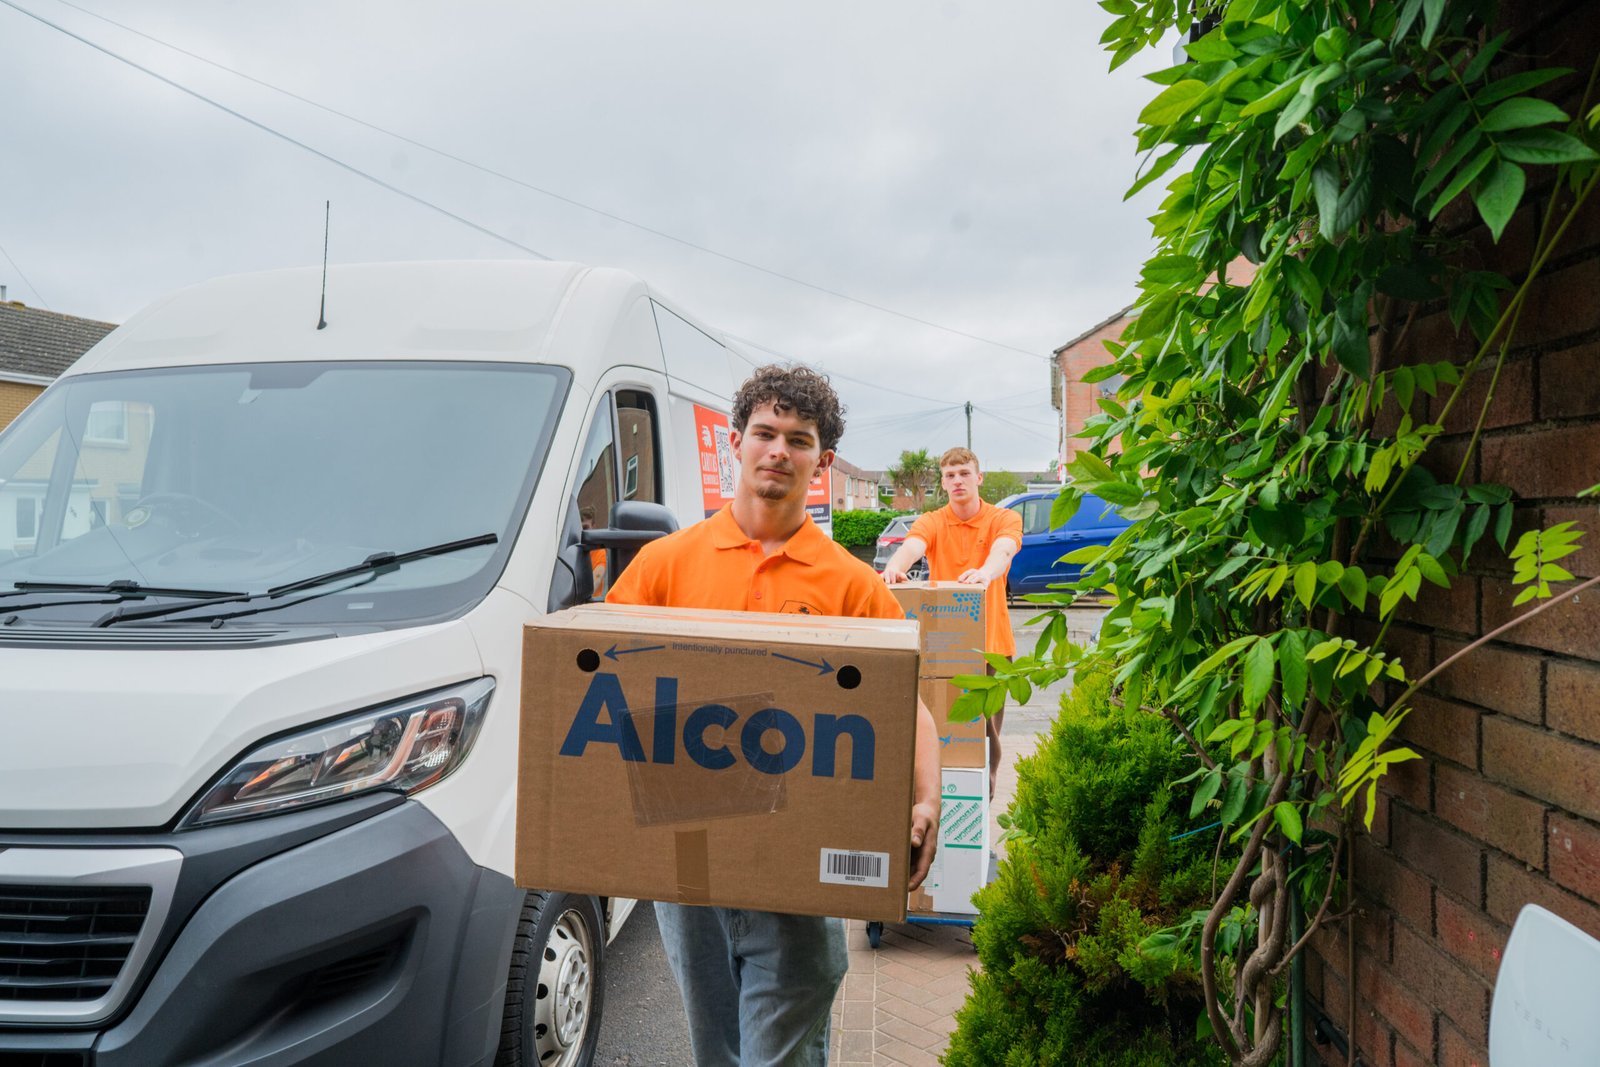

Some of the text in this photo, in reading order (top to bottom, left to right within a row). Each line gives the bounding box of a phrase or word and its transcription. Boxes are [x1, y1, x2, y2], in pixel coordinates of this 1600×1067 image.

[920, 603, 969, 613] Formula
[672, 642, 767, 657] Intentionally punctured
[559, 672, 876, 780] Alcon
[944, 802, 979, 839] INTERSURGIC
